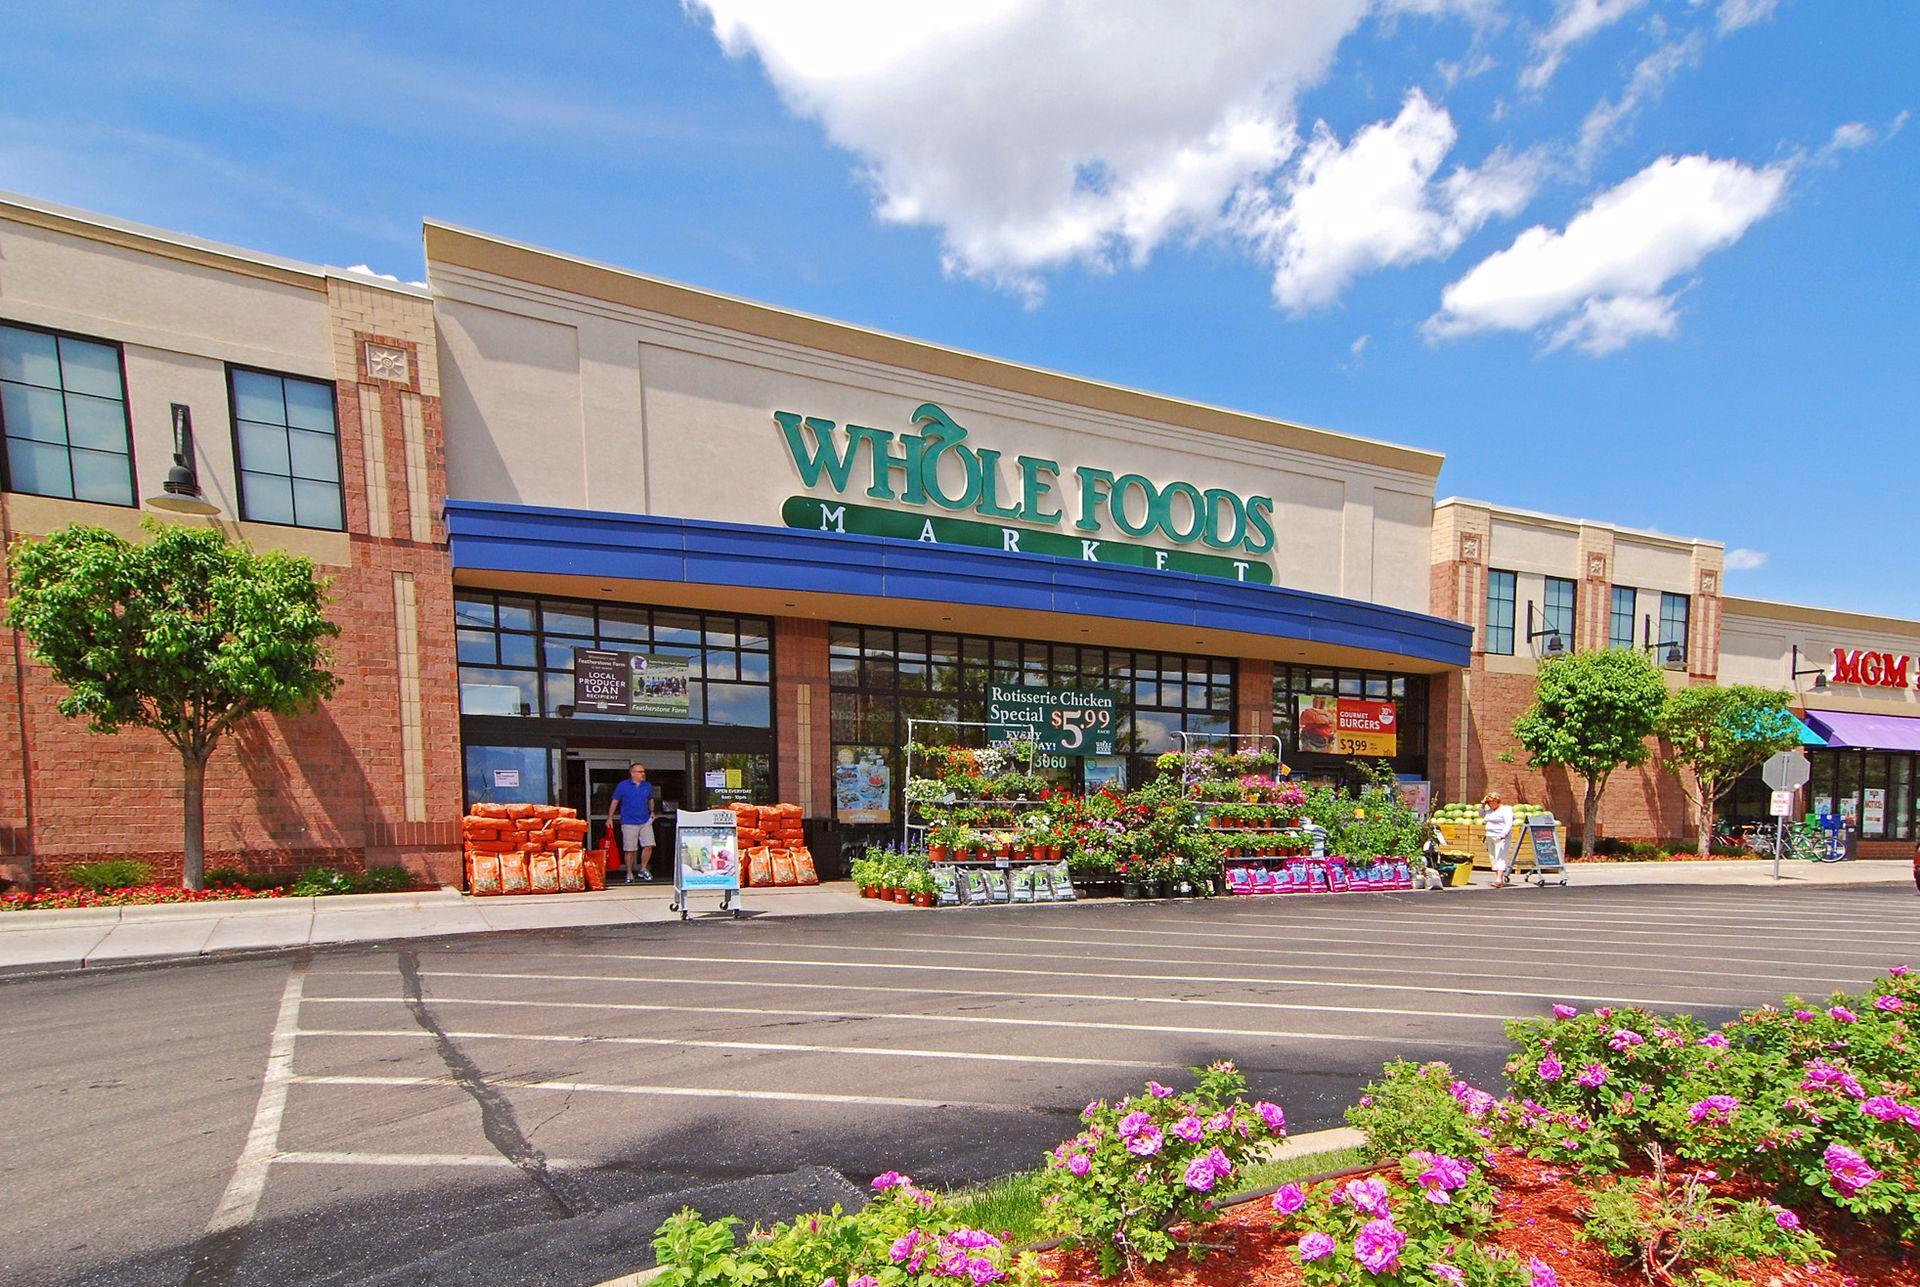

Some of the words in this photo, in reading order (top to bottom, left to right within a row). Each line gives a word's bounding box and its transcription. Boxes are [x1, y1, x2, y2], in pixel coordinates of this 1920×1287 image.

[773, 403, 1062, 526] WHOLE
[1076, 465, 1275, 555] FOODS
[819, 503, 1250, 582] MARKET
[1832, 647, 1910, 688] MGM
[588, 671, 617, 681] LOCAL
[578, 678, 626, 688] PRODUCER
[585, 685, 619, 695] LOAN
[586, 693, 618, 701] RECIPIENT
[991, 687, 1058, 705] Rotisserie
[1060, 692, 1113, 708] Chicken
[631, 704, 670, 713] Featherstone
[990, 704, 1044, 723] Special
[1339, 711, 1369, 719] GOURMET
[1051, 709, 1110, 749] $5.99
[1339, 718, 1381, 730] BURGERS
